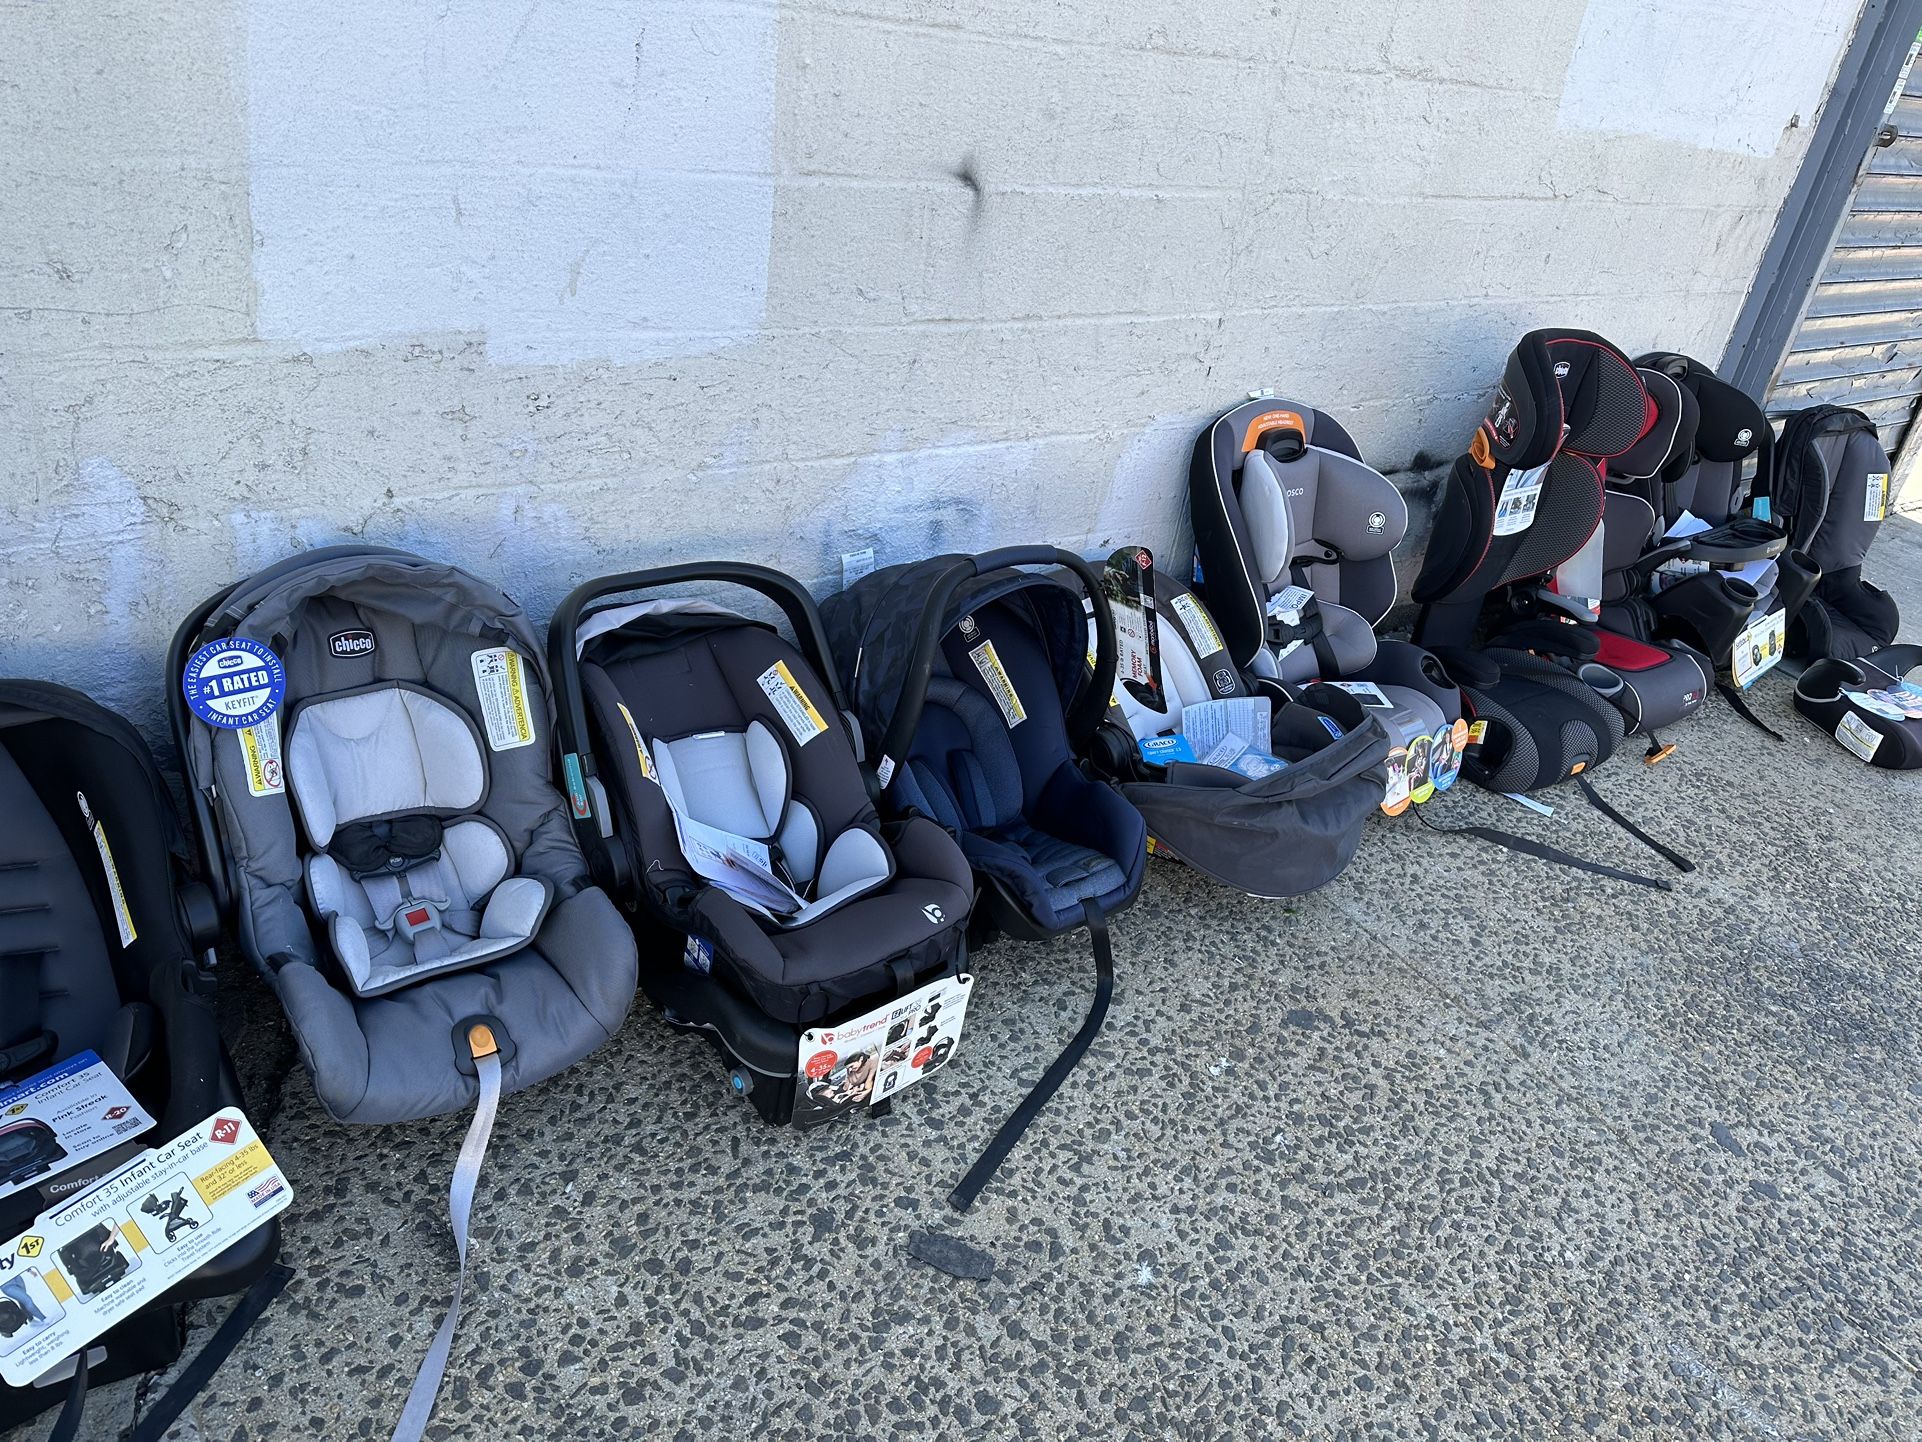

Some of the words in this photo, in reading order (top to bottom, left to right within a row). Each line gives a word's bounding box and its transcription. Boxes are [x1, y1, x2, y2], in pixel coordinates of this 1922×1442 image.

[1286, 487, 1304, 497] OSCO
[209, 642, 227, 654] CAR
[230, 641, 252, 650] SEAT
[253, 645, 264, 655] TO
[335, 634, 372, 652] chicco
[188, 651, 210, 682] EASIEST
[219, 657, 242, 667] chicco
[262, 652, 282, 683] INSTALL
[188, 685, 199, 700] THE
[203, 679, 220, 697] #1
[222, 670, 269, 692] RATED
[508, 658, 518, 688] WARNING
[514, 695, 528, 740] ADVERTENCIA
[794, 689, 811, 711] WARNING
[207, 711, 239, 725] INFANT
[242, 713, 260, 724] CAR
[259, 699, 277, 717] SEAT
[1147, 739, 1174, 747] GRACO
[837, 1016, 888, 1040] babytrend
[35, 1078, 78, 1100] Comfort
[38, 1087, 65, 1105] Infant
[65, 1081, 81, 1092] Car
[83, 1072, 103, 1085] Seat
[52, 1110, 73, 1122] Pink
[75, 1094, 108, 1112] Streak
[105, 1107, 127, 1120] R-20
[214, 1122, 236, 1140] R-11
[200, 1159, 235, 1183] Rear-facing
[234, 1149, 249, 1162] 4-35
[205, 1180, 218, 1190] and
[236, 1160, 248, 1169] less
[50, 1176, 98, 1194] Comfort
[54, 1194, 101, 1227] Comfort
[102, 1183, 119, 1198] 35
[120, 1161, 157, 1188] Infant
[157, 1148, 176, 1165] Car
[177, 1131, 204, 1152] Seat
[91, 1203, 111, 1219] with
[111, 1177, 151, 1206] adjustable
[152, 1154, 190, 1182] stay-in-car
[190, 1141, 209, 1158] base
[251, 1192, 265, 1203] MADE
[21, 1239, 40, 1255] 1ST
